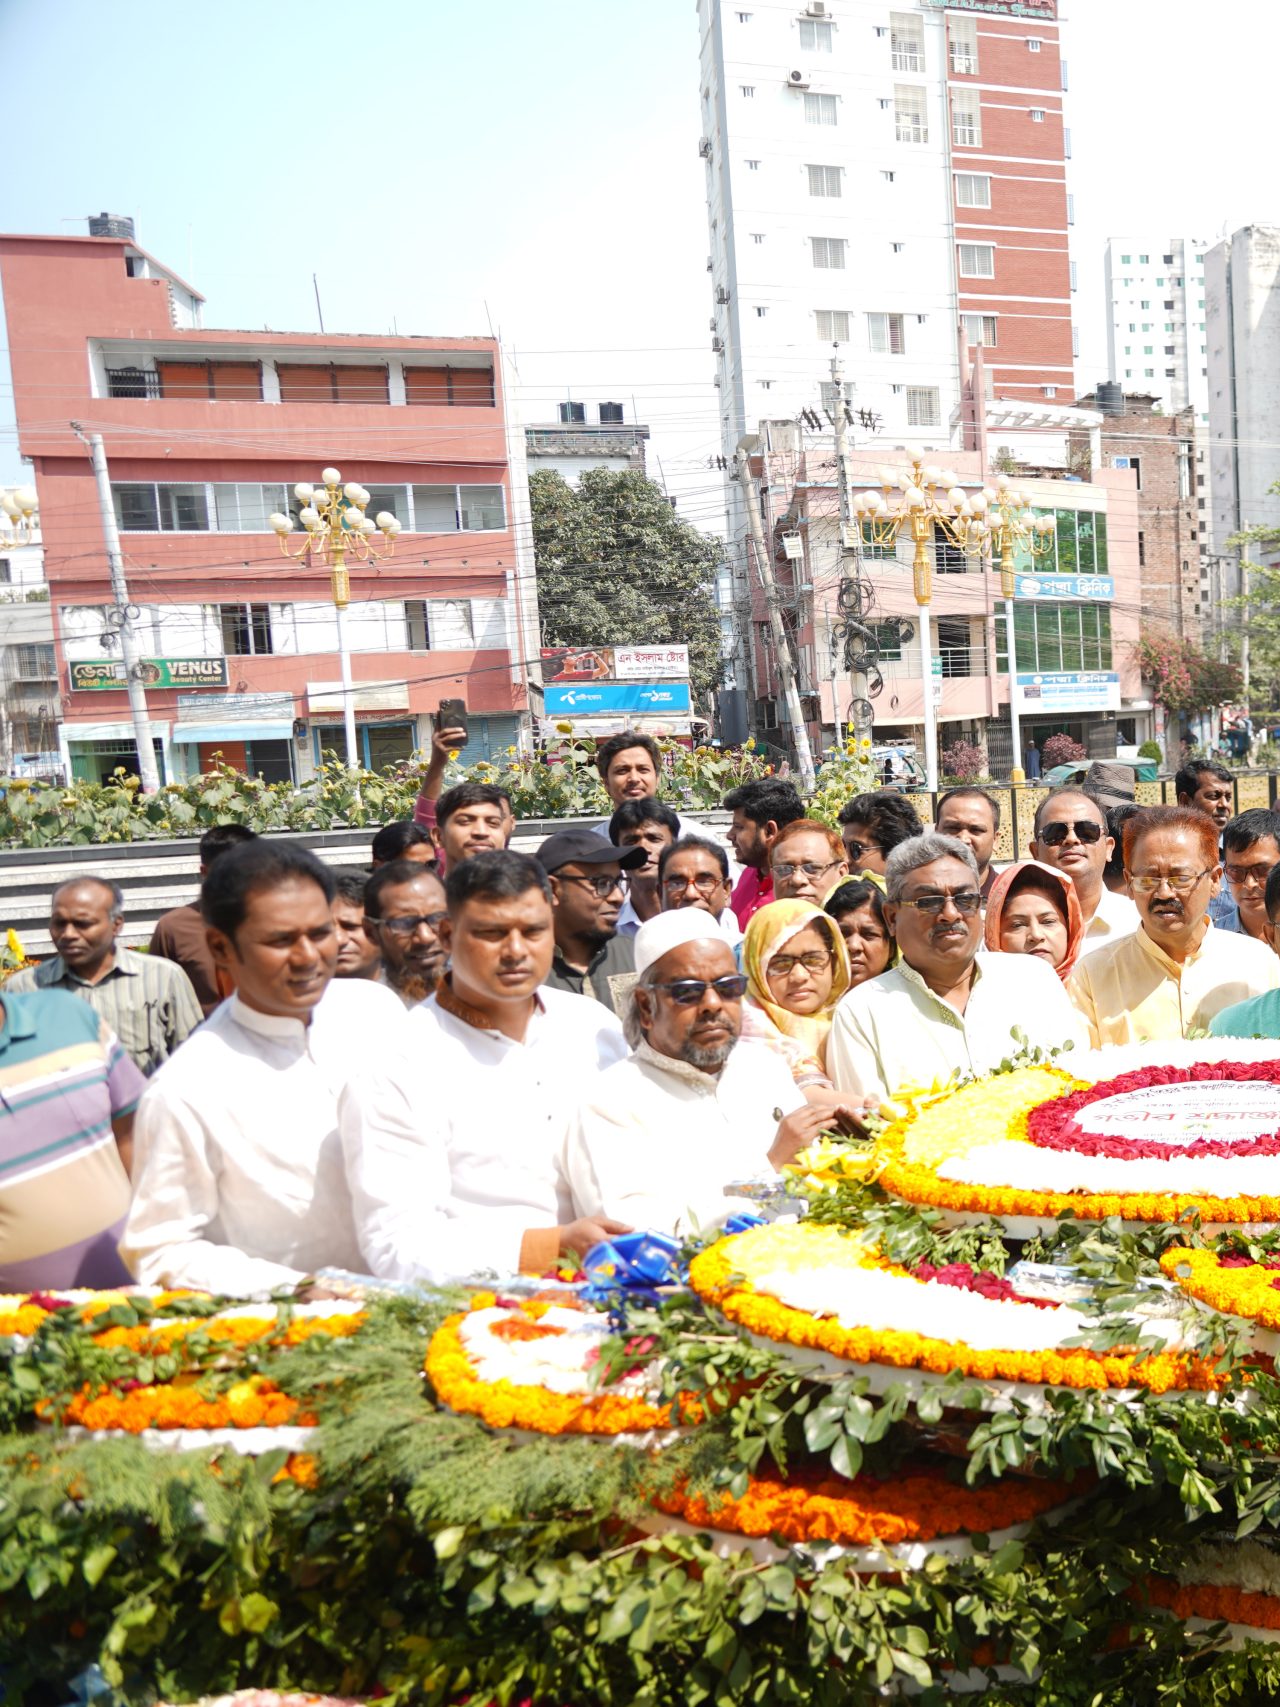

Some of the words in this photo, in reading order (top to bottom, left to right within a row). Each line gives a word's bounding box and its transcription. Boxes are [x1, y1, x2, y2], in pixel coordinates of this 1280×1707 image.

[633, 650, 664, 663] ইসলাম
[74, 662, 118, 678] ভেনা
[165, 661, 223, 676] VENUS
[170, 676, 196, 684] Beauty
[198, 675, 222, 683] Center
[1093, 1110, 1177, 1122] গভীর
